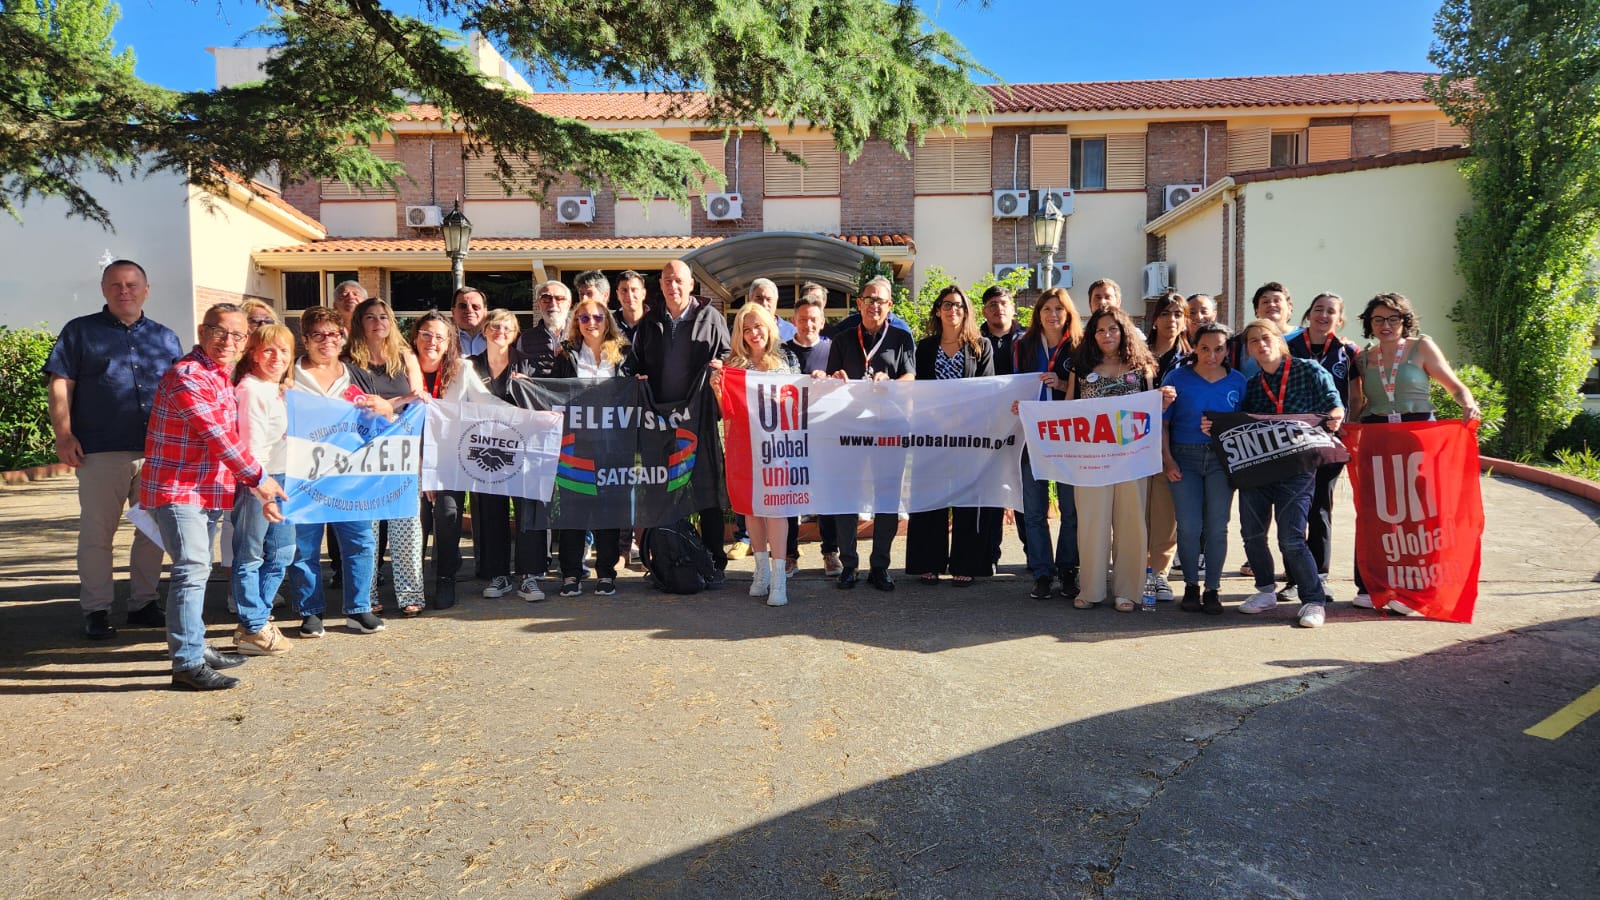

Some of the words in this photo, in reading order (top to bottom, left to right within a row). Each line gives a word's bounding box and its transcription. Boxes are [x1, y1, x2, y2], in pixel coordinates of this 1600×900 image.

[309, 417, 348, 437] SINDICO
[470, 434, 518, 448] SINTECI
[762, 433, 808, 465] global
[839, 434, 1015, 450] www.uniglobalunion.org
[597, 466, 668, 486] SATSAID
[762, 461, 810, 487] union
[764, 490, 810, 506] americas
[1381, 520, 1456, 563] global
